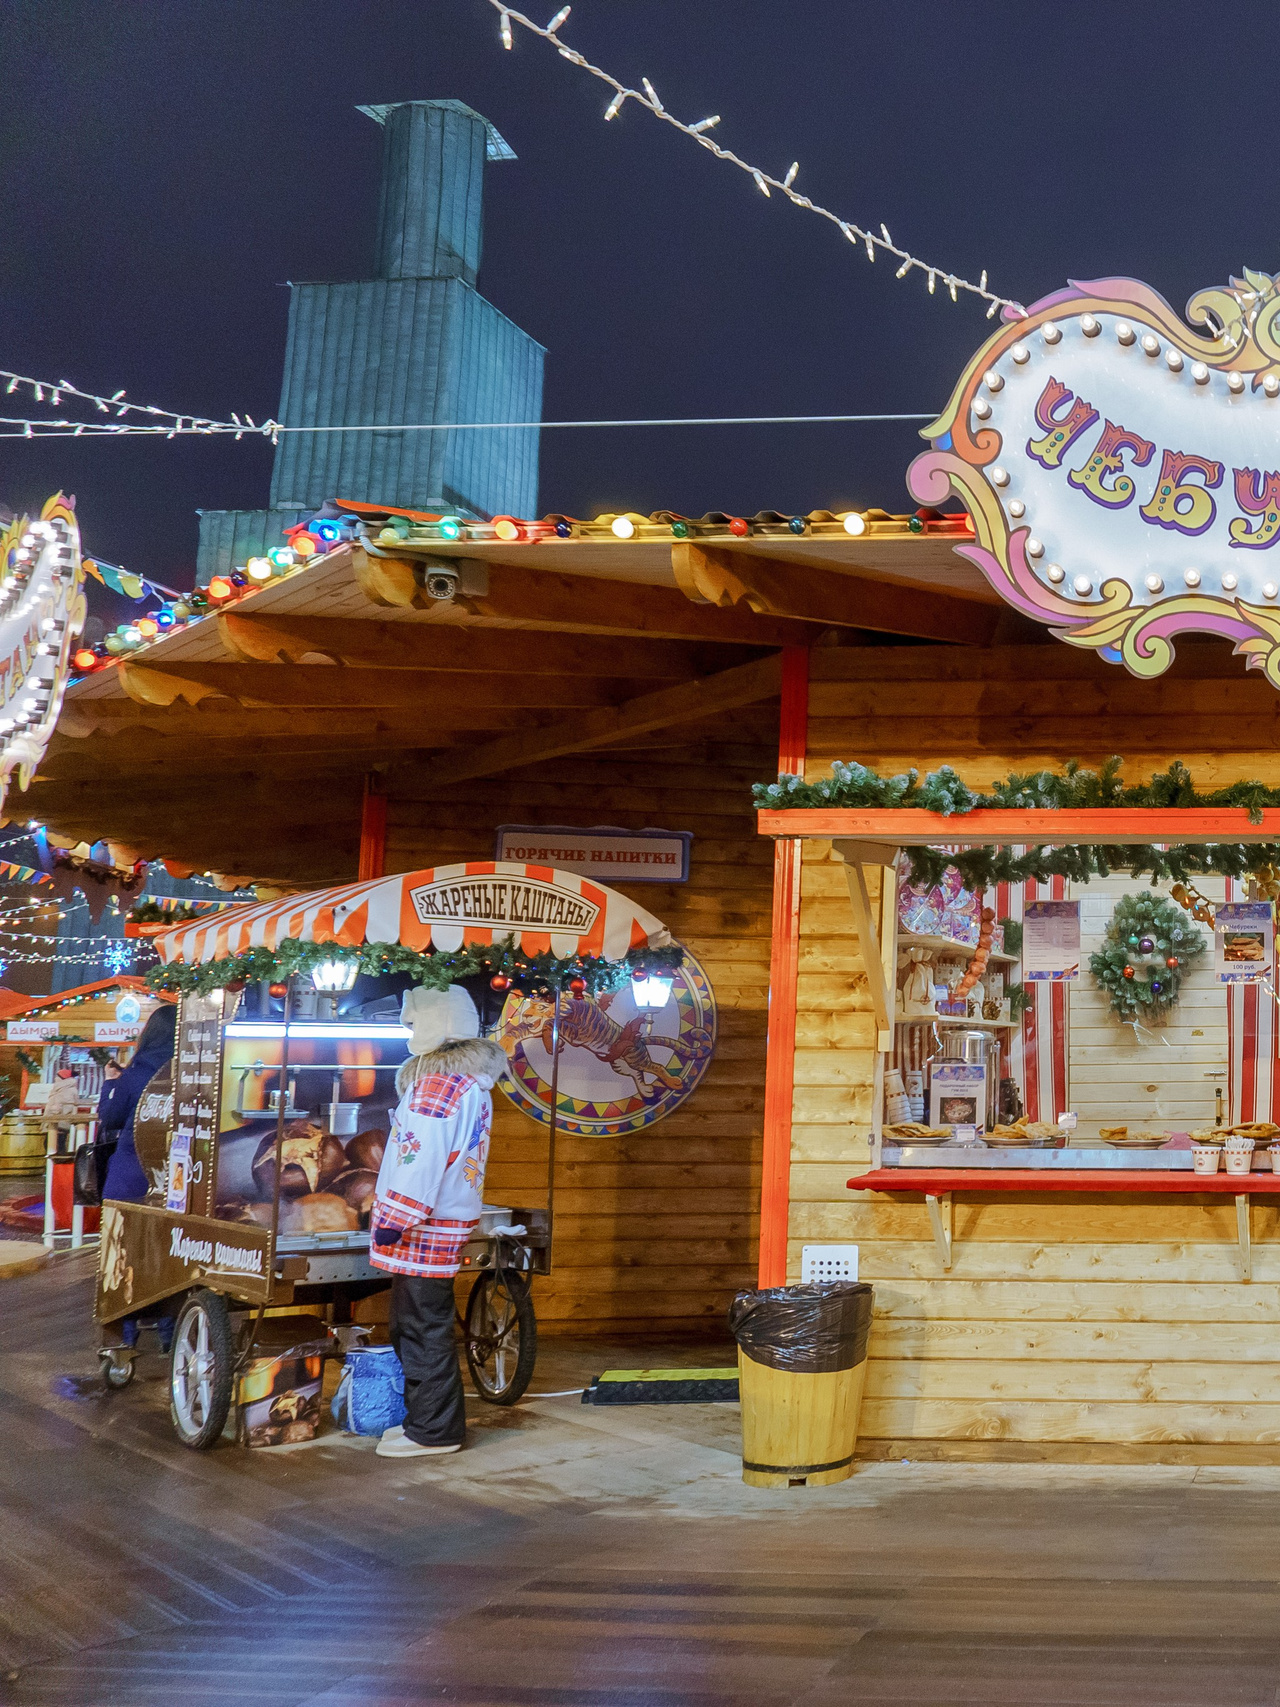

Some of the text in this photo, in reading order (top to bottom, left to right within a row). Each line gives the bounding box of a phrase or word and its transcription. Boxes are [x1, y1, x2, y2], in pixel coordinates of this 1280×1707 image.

[505, 846, 677, 865] ГОРЯЧИЕ НАПИТКИ
[420, 883, 592, 926] ЖАРЕНЫЕ КАШТАНЫ
[9, 1027, 58, 1037] ДЫМОВ
[96, 1027, 142, 1037] ДЫМО
